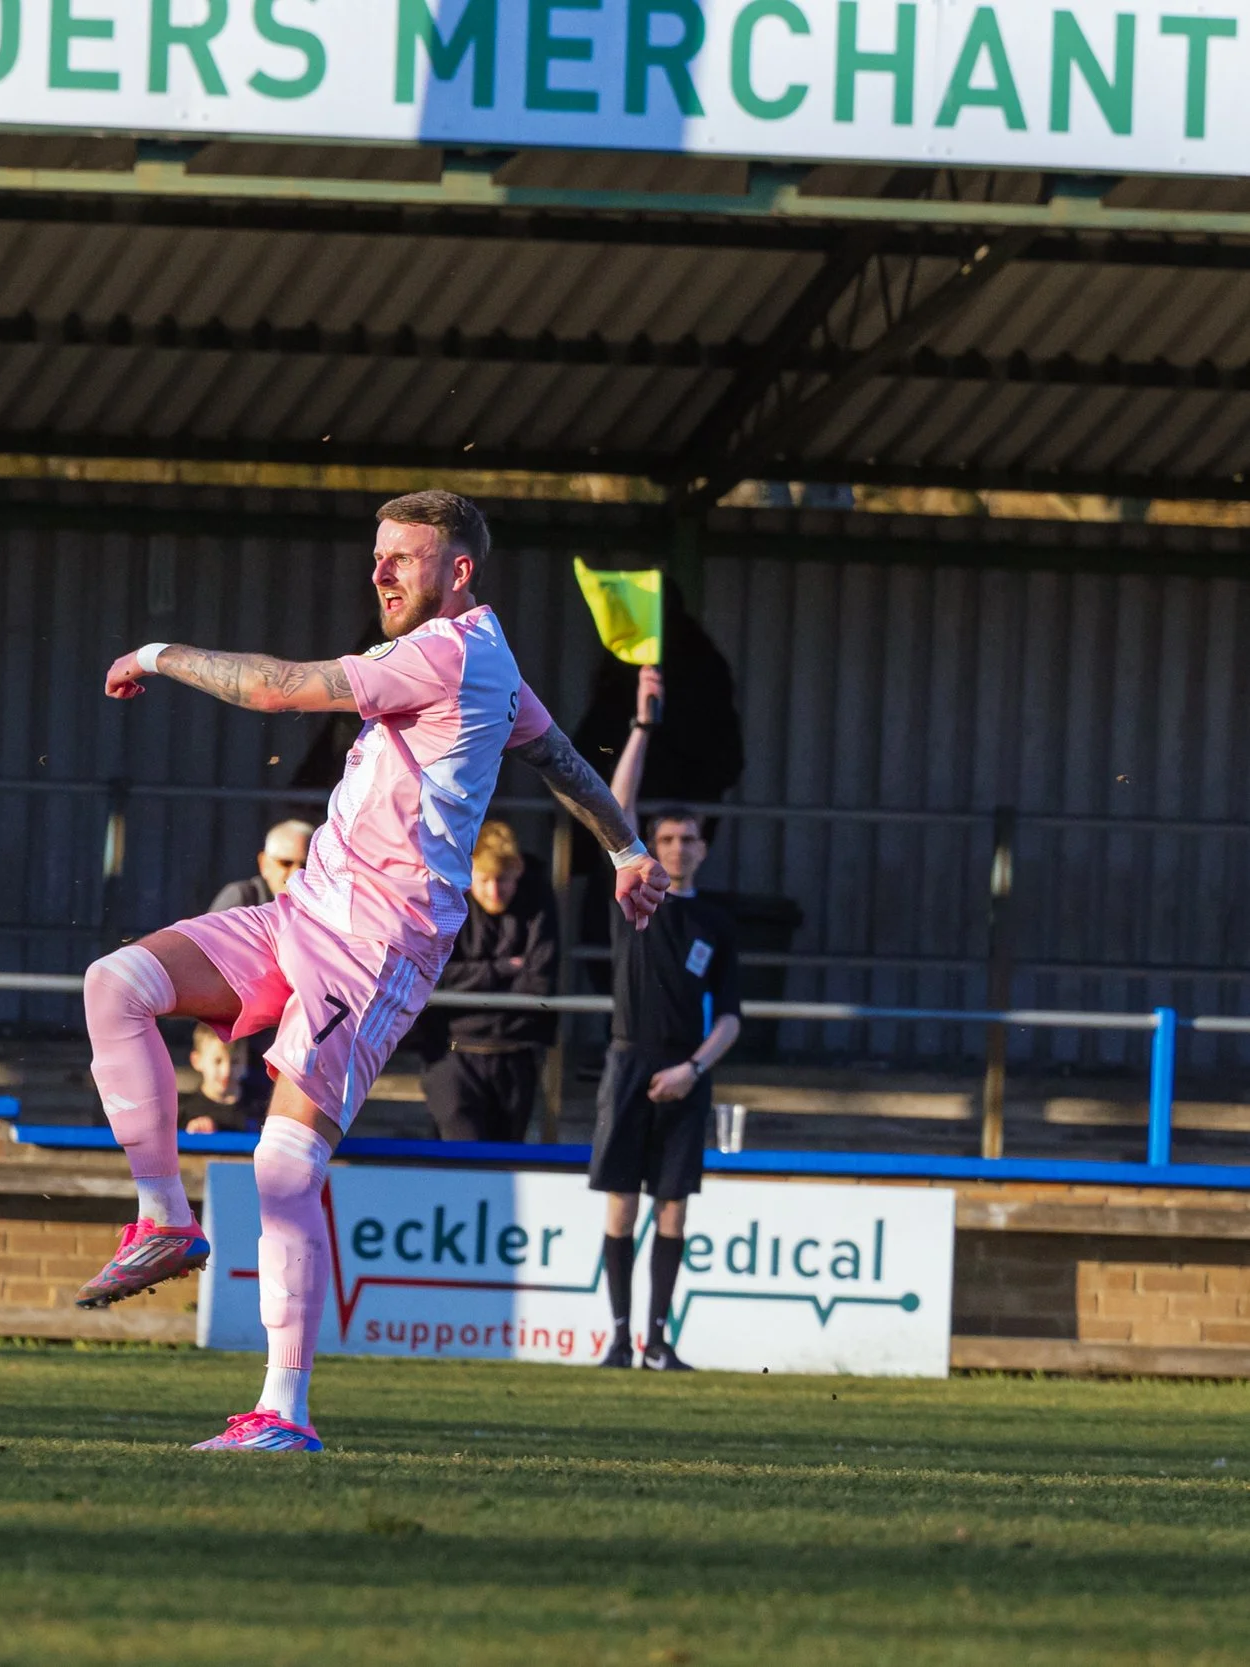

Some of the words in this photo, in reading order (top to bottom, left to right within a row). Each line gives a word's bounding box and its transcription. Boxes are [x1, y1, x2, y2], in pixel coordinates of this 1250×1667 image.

[393, 0, 1239, 140] MERCHANT
[312, 993, 351, 1046] 7
[365, 1313, 575, 1357] supporting
